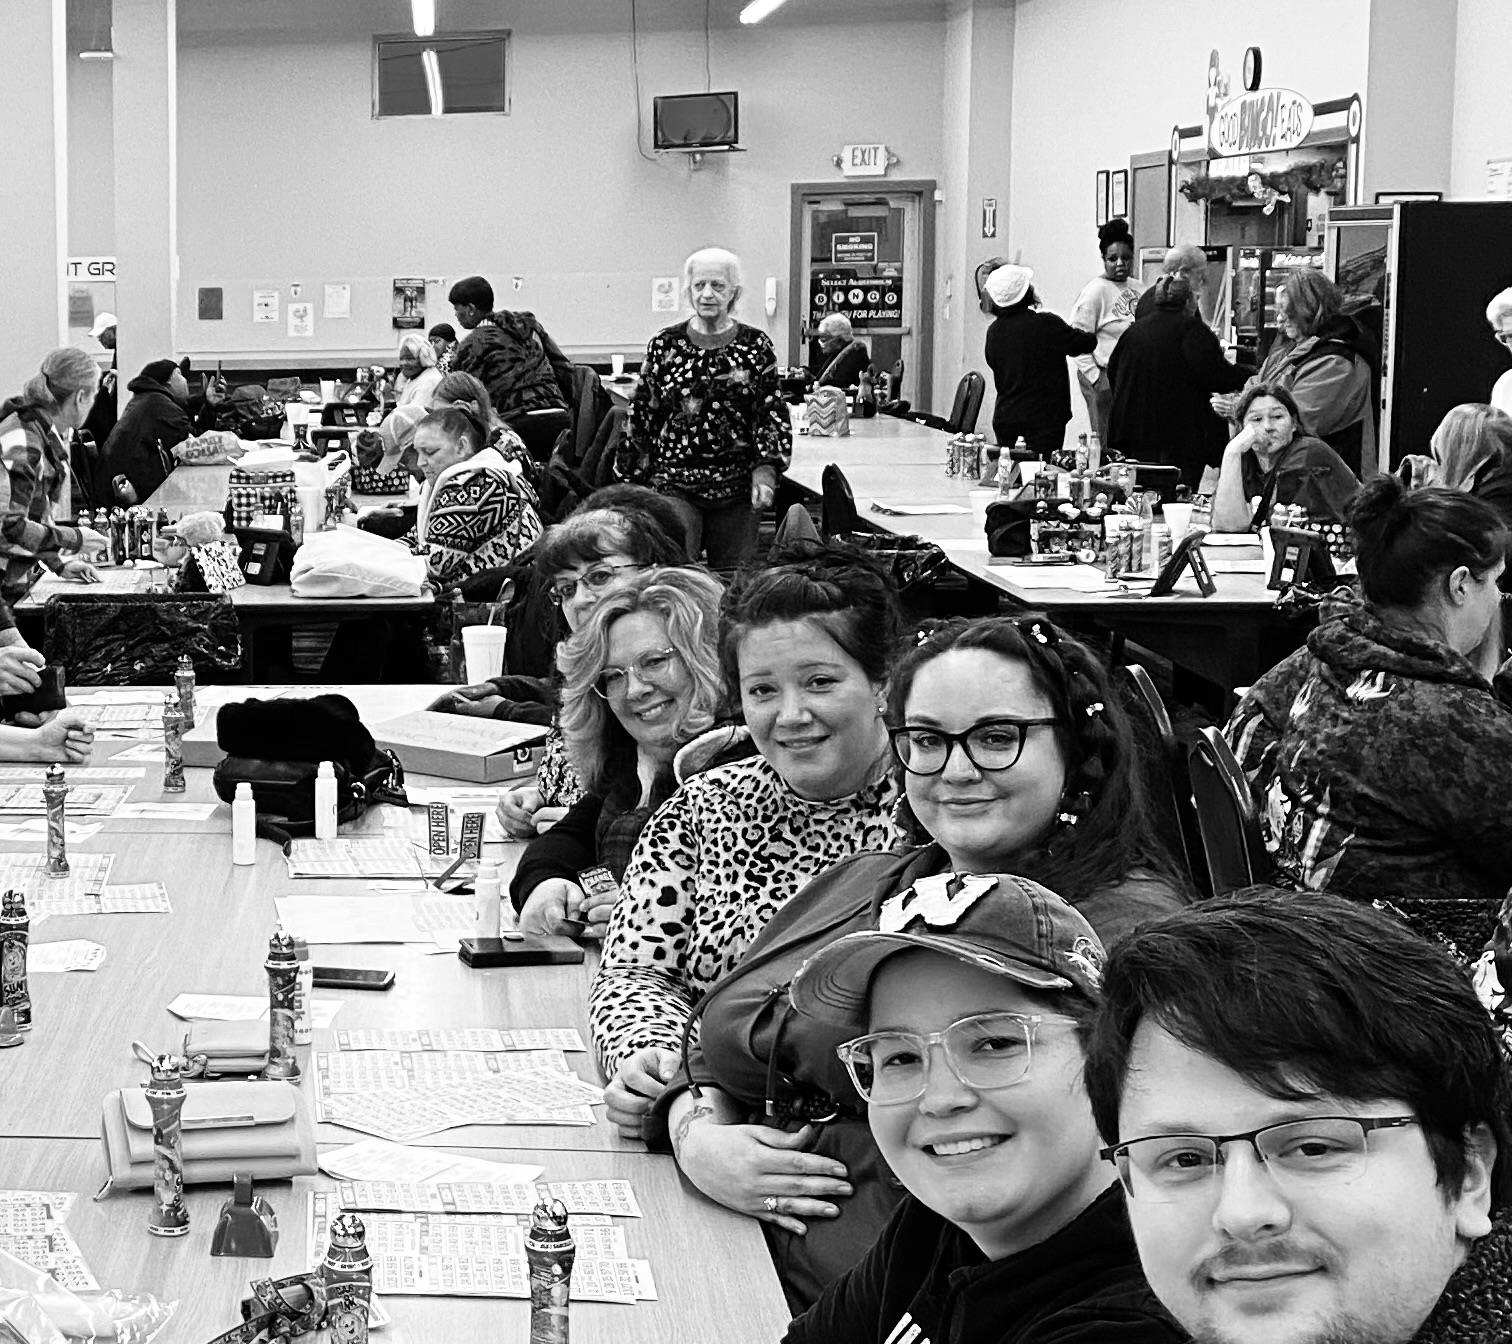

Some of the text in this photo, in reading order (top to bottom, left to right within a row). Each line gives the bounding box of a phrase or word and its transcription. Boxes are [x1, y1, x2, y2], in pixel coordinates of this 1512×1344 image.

[851, 146, 879, 167] EXIT
[853, 310, 867, 319] FOR
[431, 805, 446, 855] OPEN HERE
